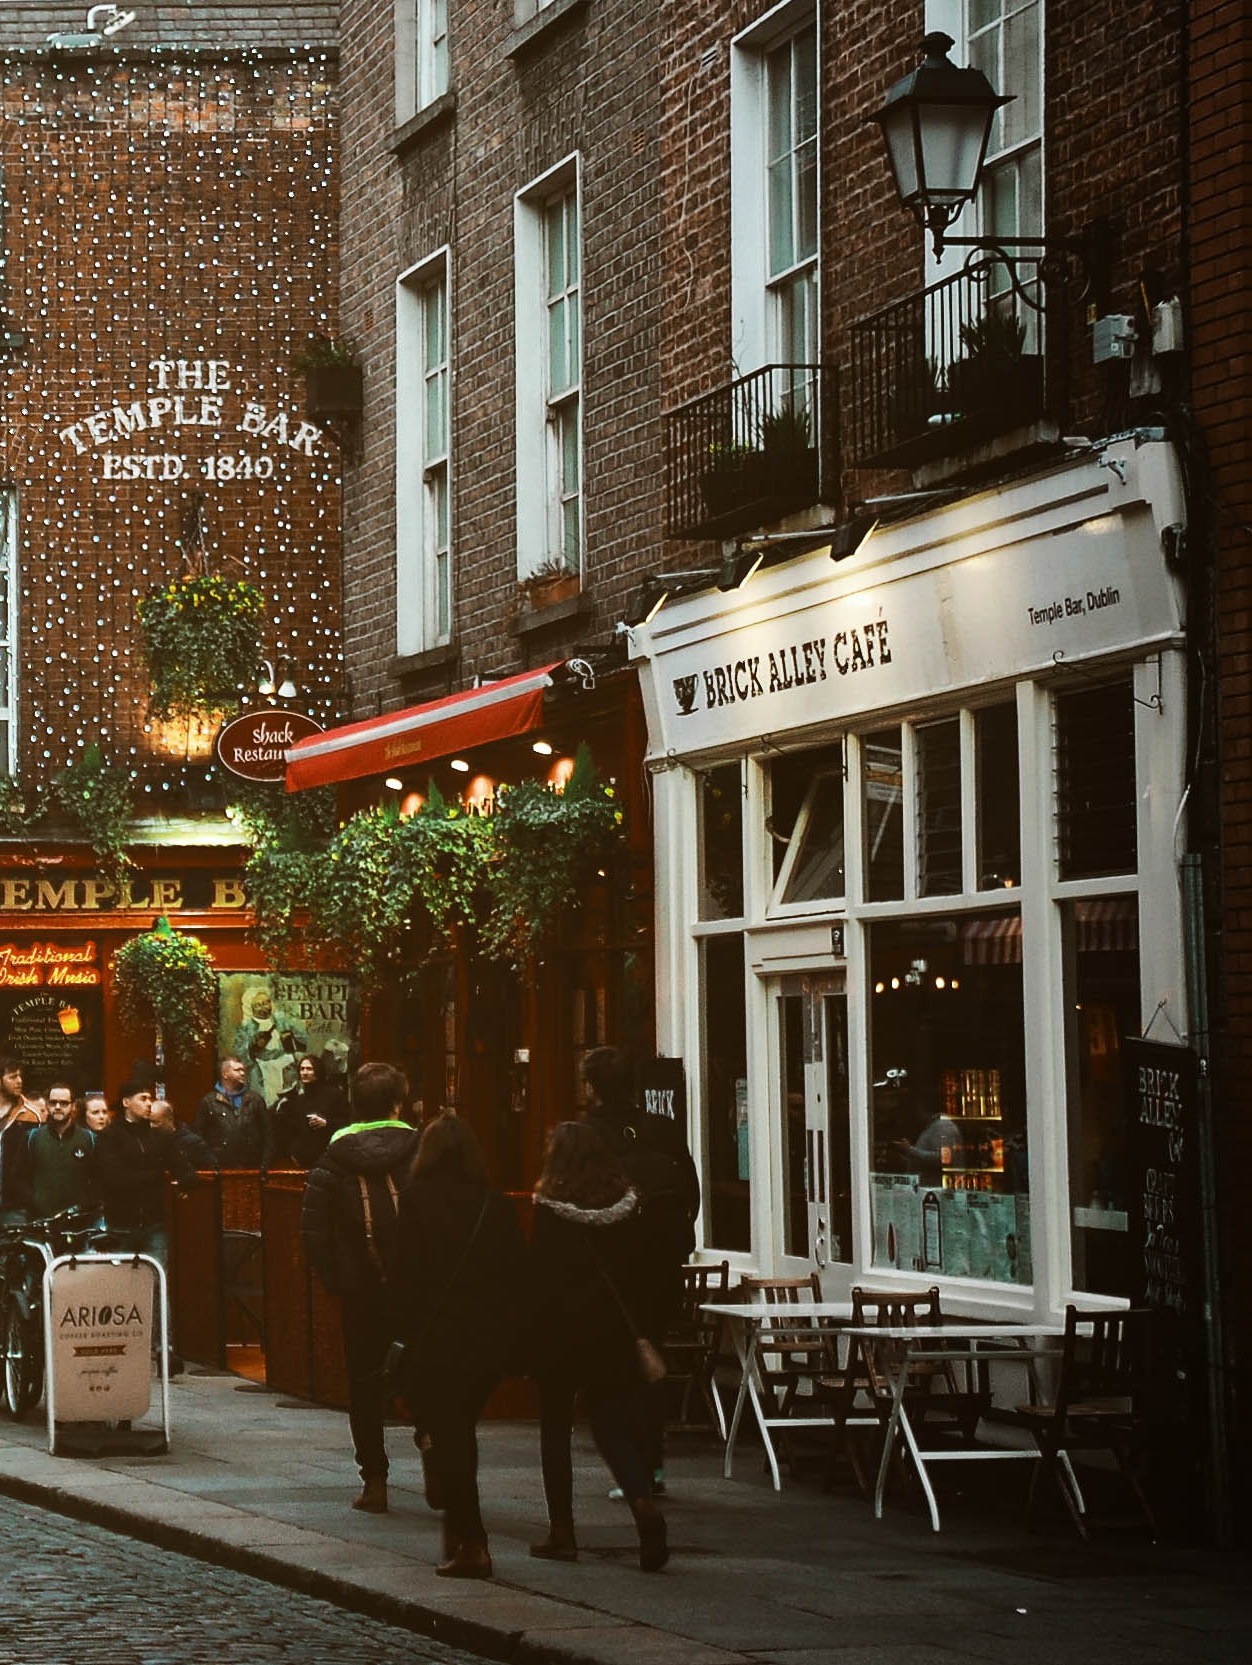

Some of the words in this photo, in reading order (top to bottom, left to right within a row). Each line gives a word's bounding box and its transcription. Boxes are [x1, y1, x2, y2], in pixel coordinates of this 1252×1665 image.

[150, 360, 230, 390] THE
[59, 396, 224, 456] TEMPLE
[241, 402, 323, 457] BAR
[101, 454, 190, 481] ESTD.
[204, 455, 274, 481] 1840
[1027, 602, 1064, 625] Temple
[1064, 597, 1087, 616] Bar,
[1086, 586, 1121, 611] Dublin
[703, 656, 764, 709] BRICK
[768, 638, 828, 693] ALLEY
[833, 606, 893, 676] CAFÉ
[252, 721, 294, 746] Shack
[233, 746, 283, 764] Restau
[48, 966, 97, 985] Music
[300, 1002, 348, 1022] BAR
[1138, 1066, 1180, 1100] BRICK
[644, 1088, 675, 1121] BRICK
[1139, 1096, 1183, 1130] ALLEY
[60, 1304, 143, 1328] ARIOSA
